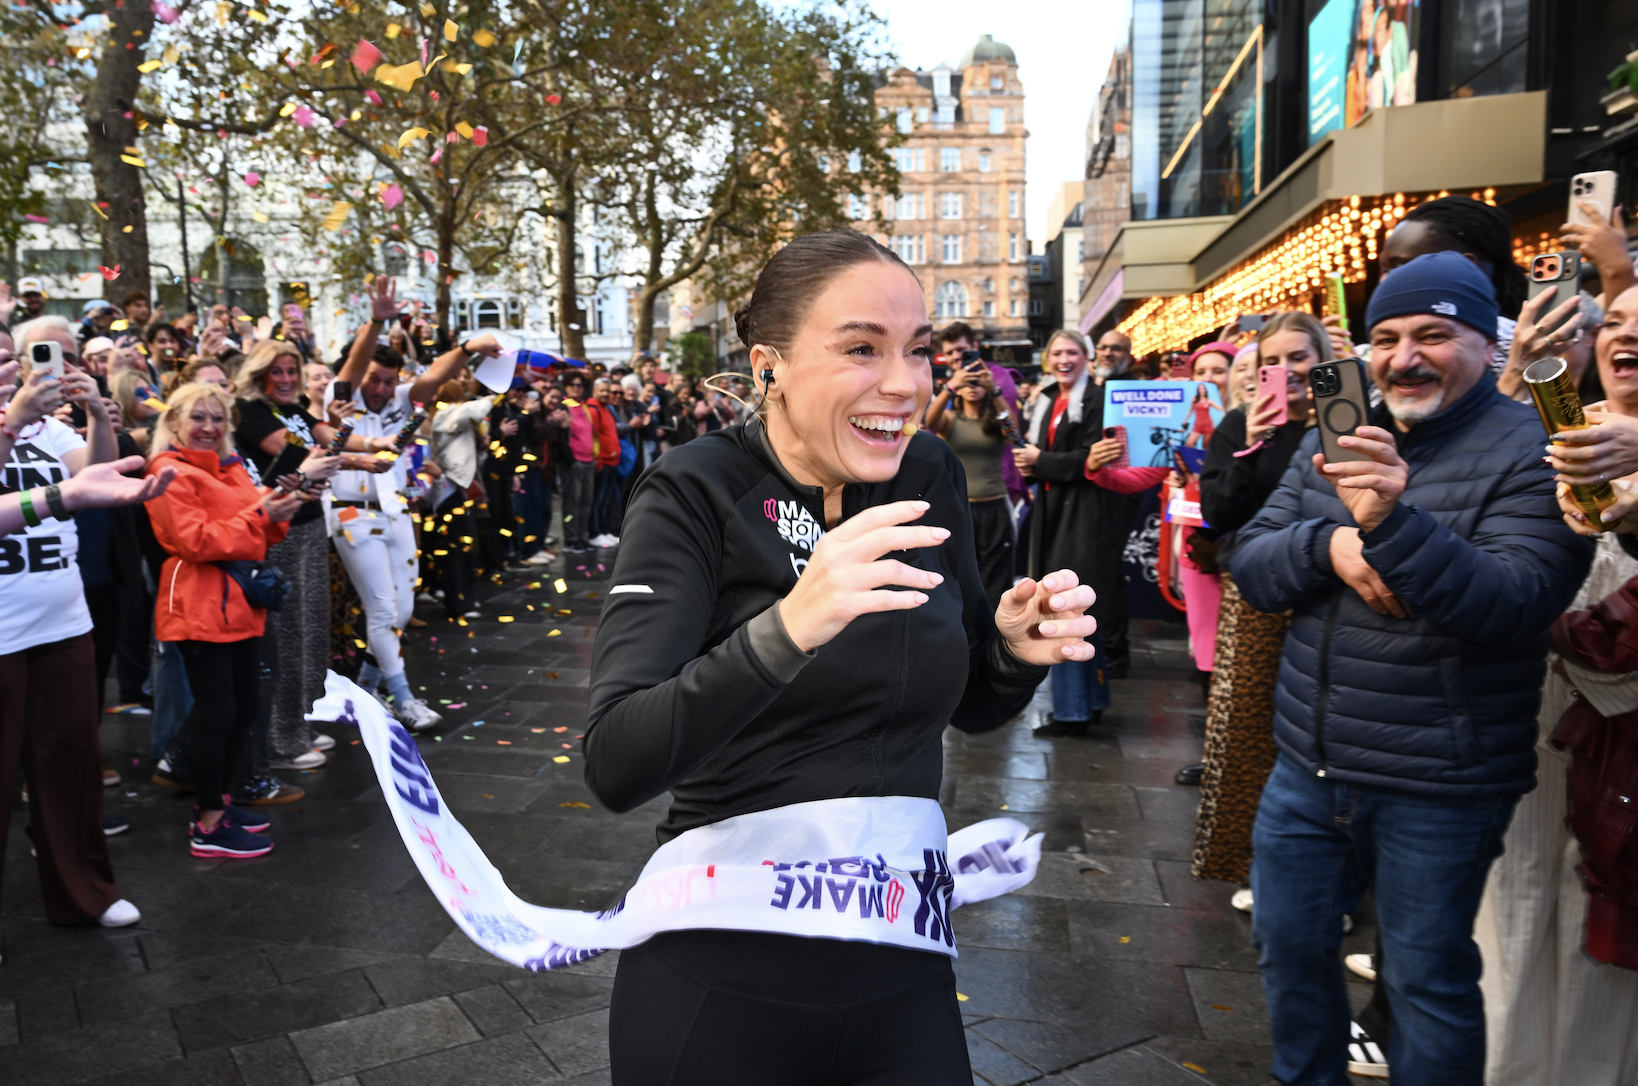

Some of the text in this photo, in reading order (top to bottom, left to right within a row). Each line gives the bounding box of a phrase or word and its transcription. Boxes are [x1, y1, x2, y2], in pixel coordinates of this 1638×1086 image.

[1112, 390, 1182, 402] WELL DONE
[1127, 405, 1168, 415] VICKY!
[770, 872, 885, 919] MAKE
